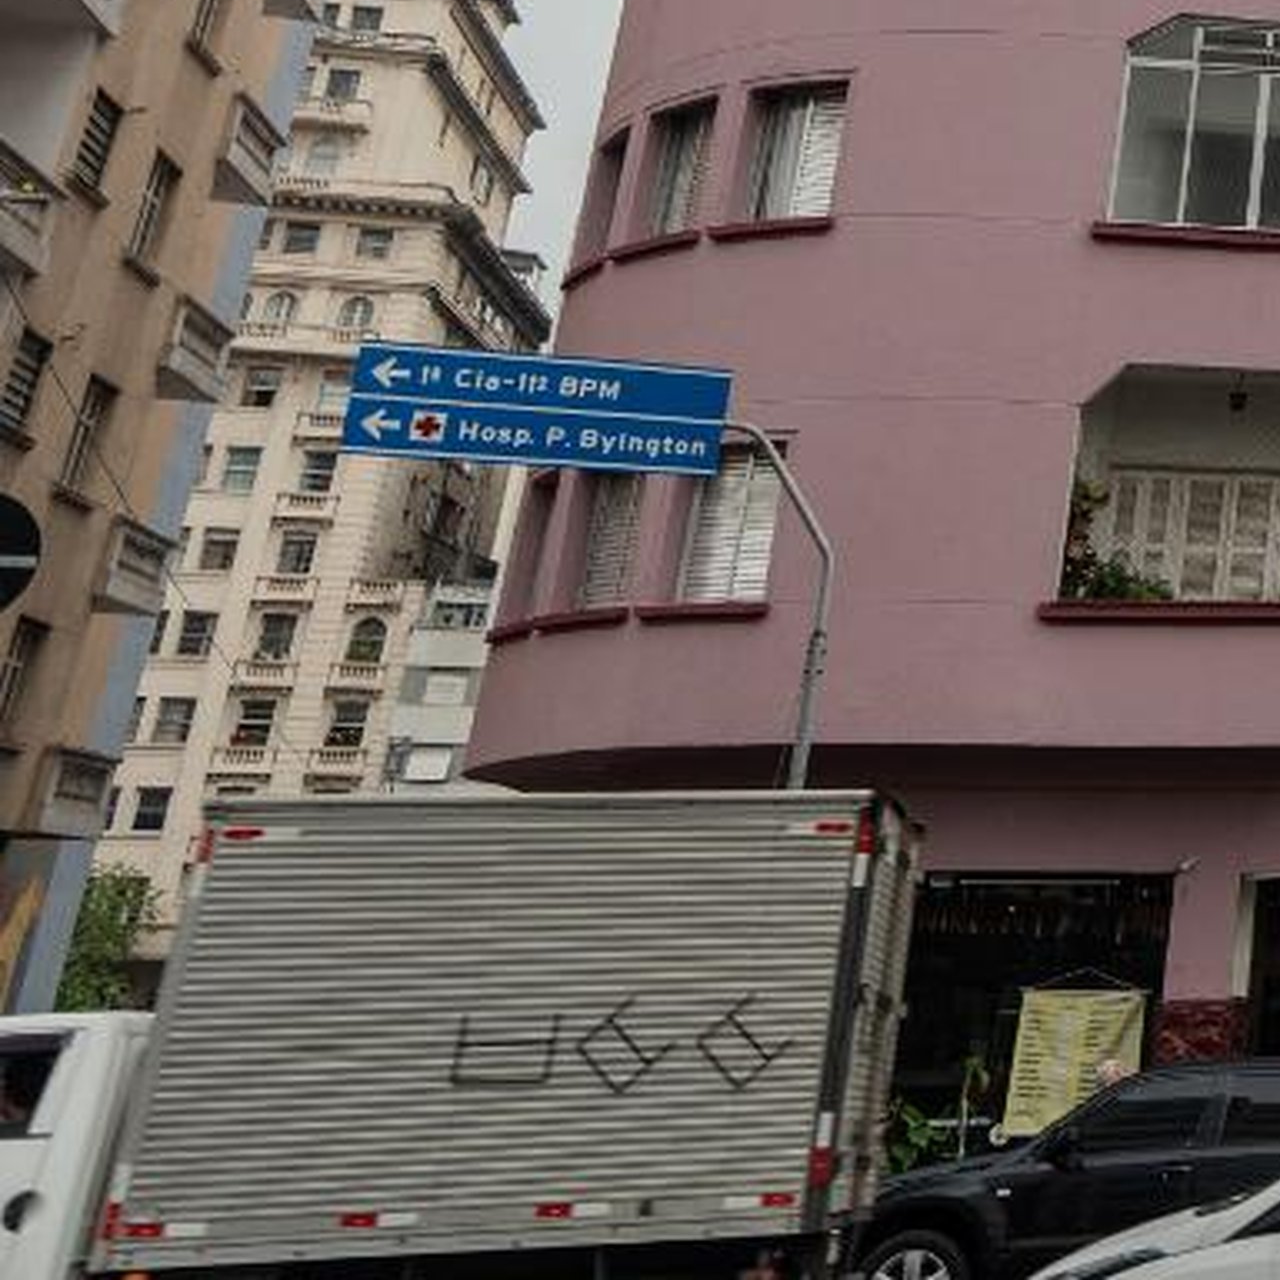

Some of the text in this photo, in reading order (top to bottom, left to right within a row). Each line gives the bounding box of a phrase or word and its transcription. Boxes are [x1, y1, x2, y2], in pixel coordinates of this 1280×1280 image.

[558, 375, 622, 401] BPM
[458, 420, 707, 458] Hosp. P. Byington
